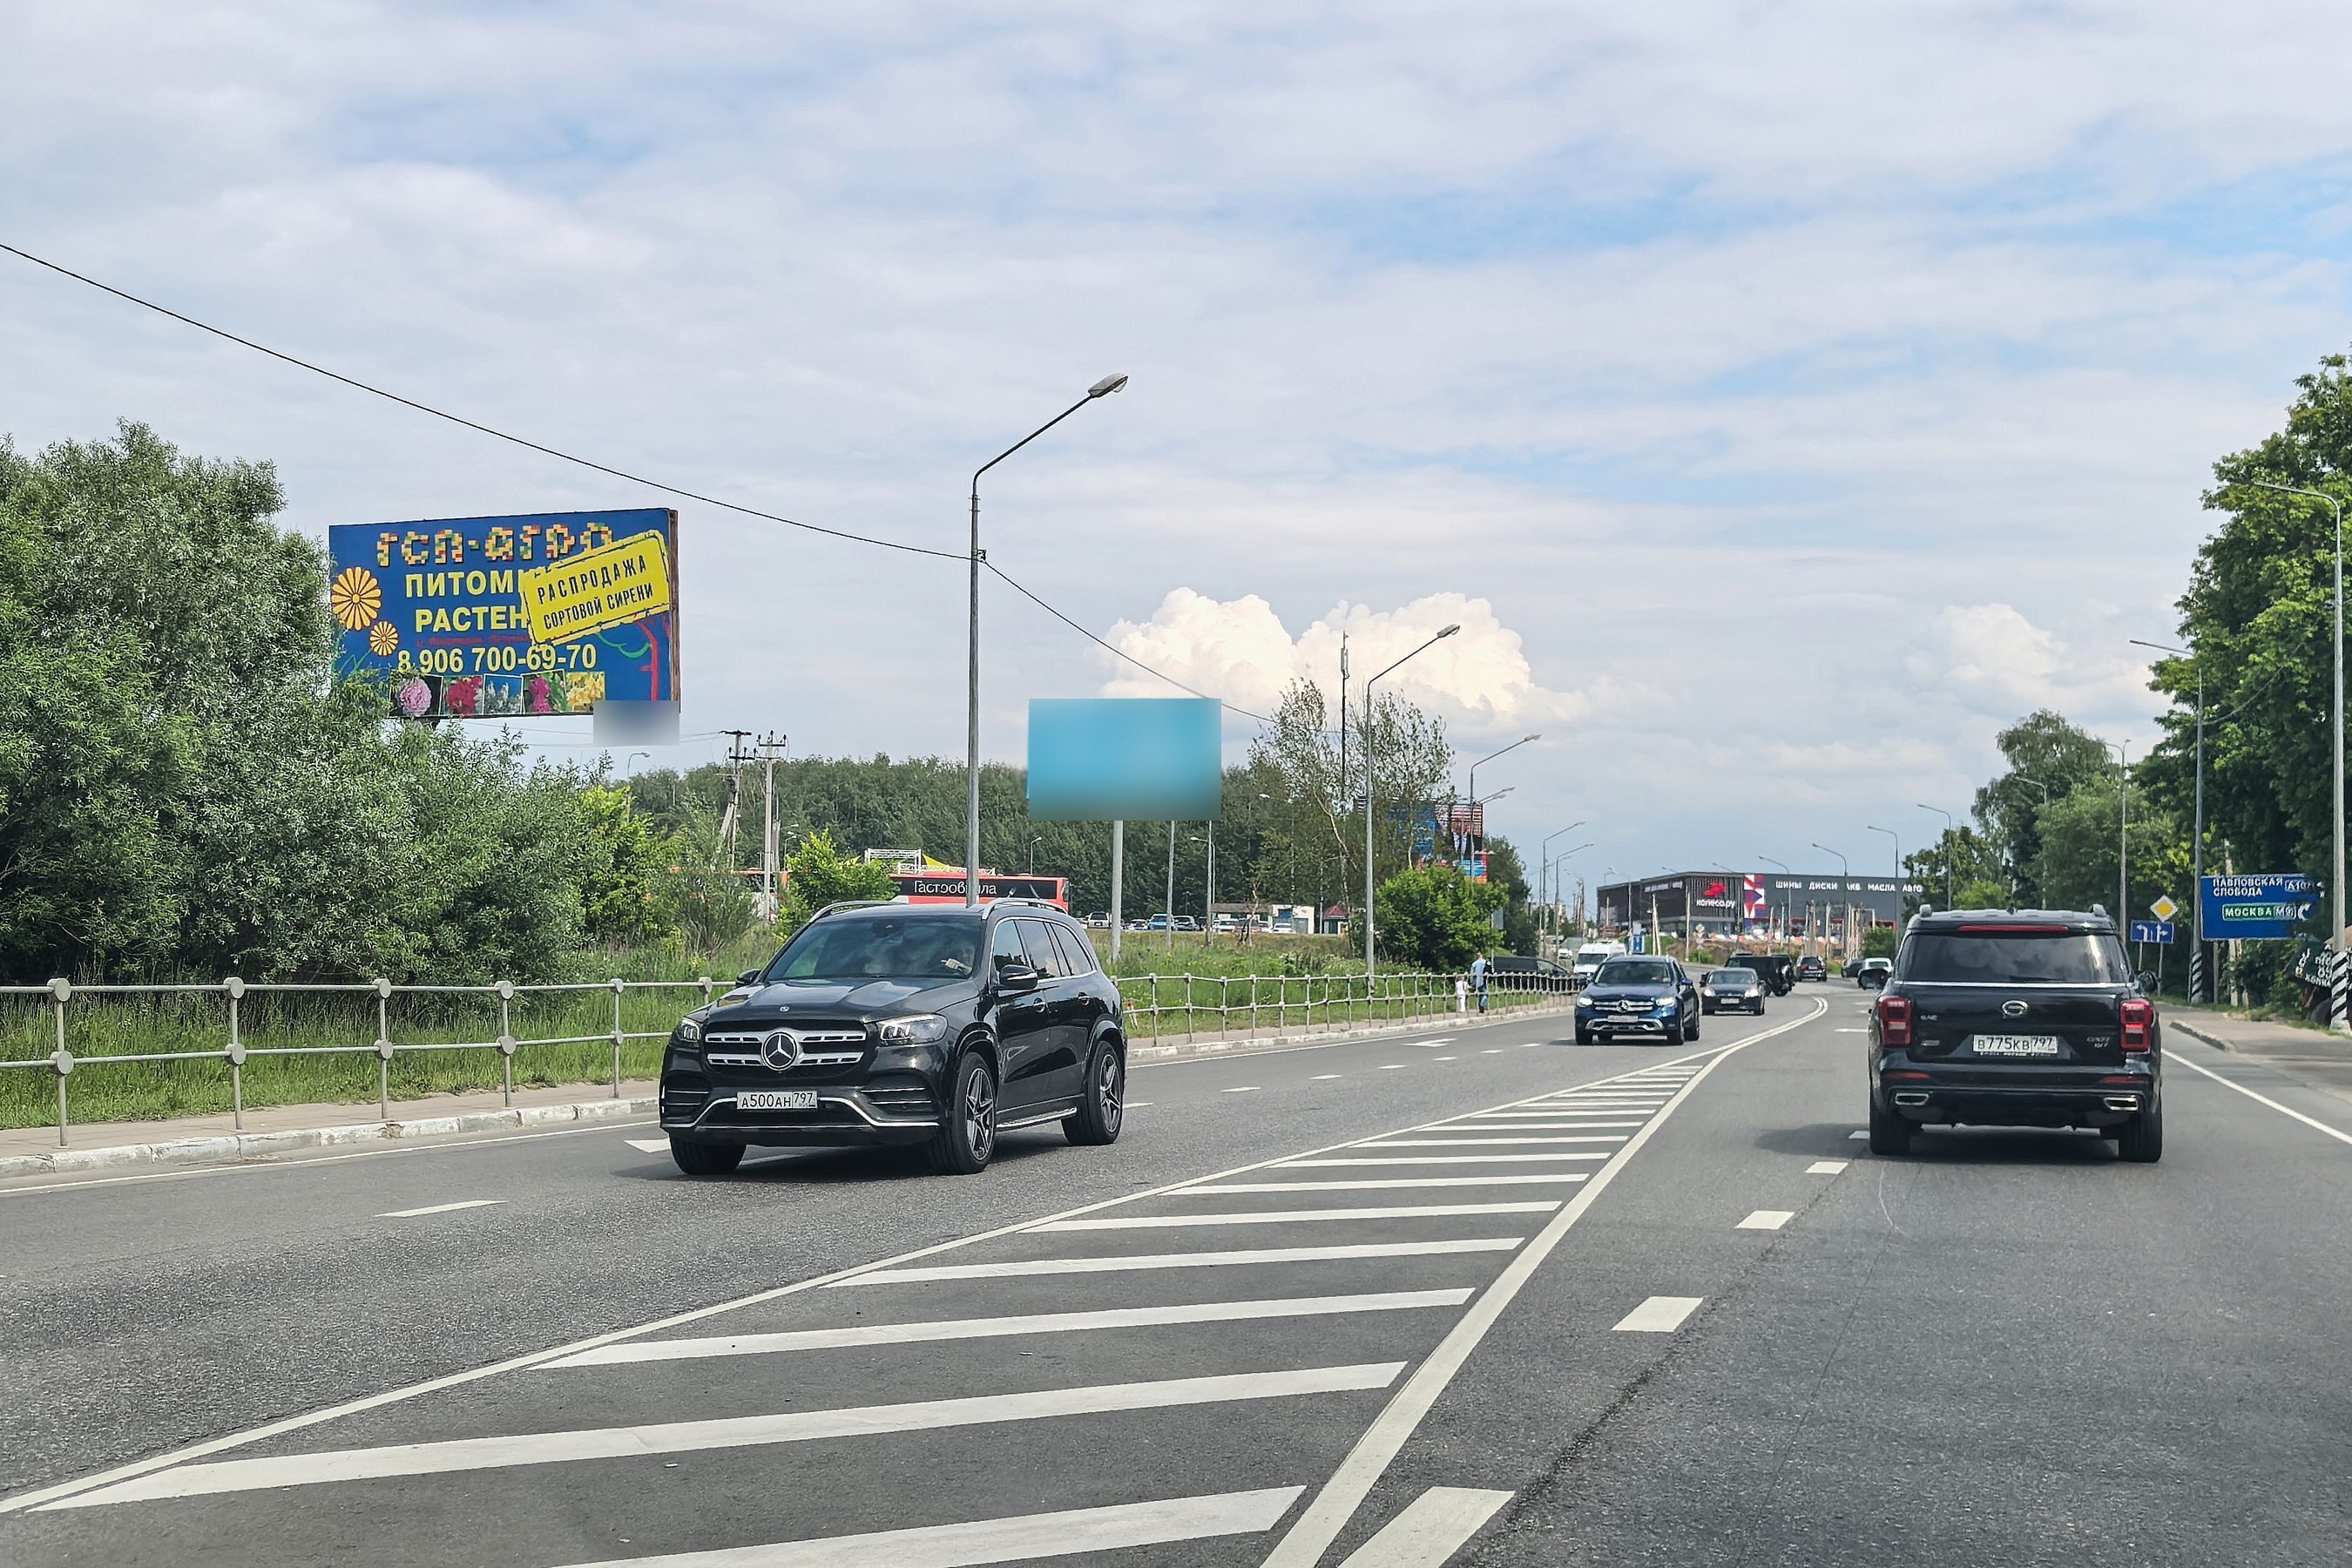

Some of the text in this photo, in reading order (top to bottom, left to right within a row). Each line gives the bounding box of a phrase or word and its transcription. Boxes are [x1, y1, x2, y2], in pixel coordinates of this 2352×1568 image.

[537, 555, 647, 605] РАСПРОДАЖА
[544, 583, 653, 630] СОРТОВОЙ СИРЕНИ
[415, 605, 528, 633] РАСТЕН
[398, 644, 597, 673] 8 906 700-69-70
[1775, 881, 1802, 889] ШИНЫ
[1808, 882, 1839, 890] ДИСКИ
[1867, 882, 1896, 892] МАСЛА
[2213, 876, 2283, 888] ПАВЛОВСКАЯ
[2213, 887, 2263, 897] СЛОБОДА
[2224, 906, 2273, 917] МОСКВА
[741, 1094, 792, 1108] А500АН
